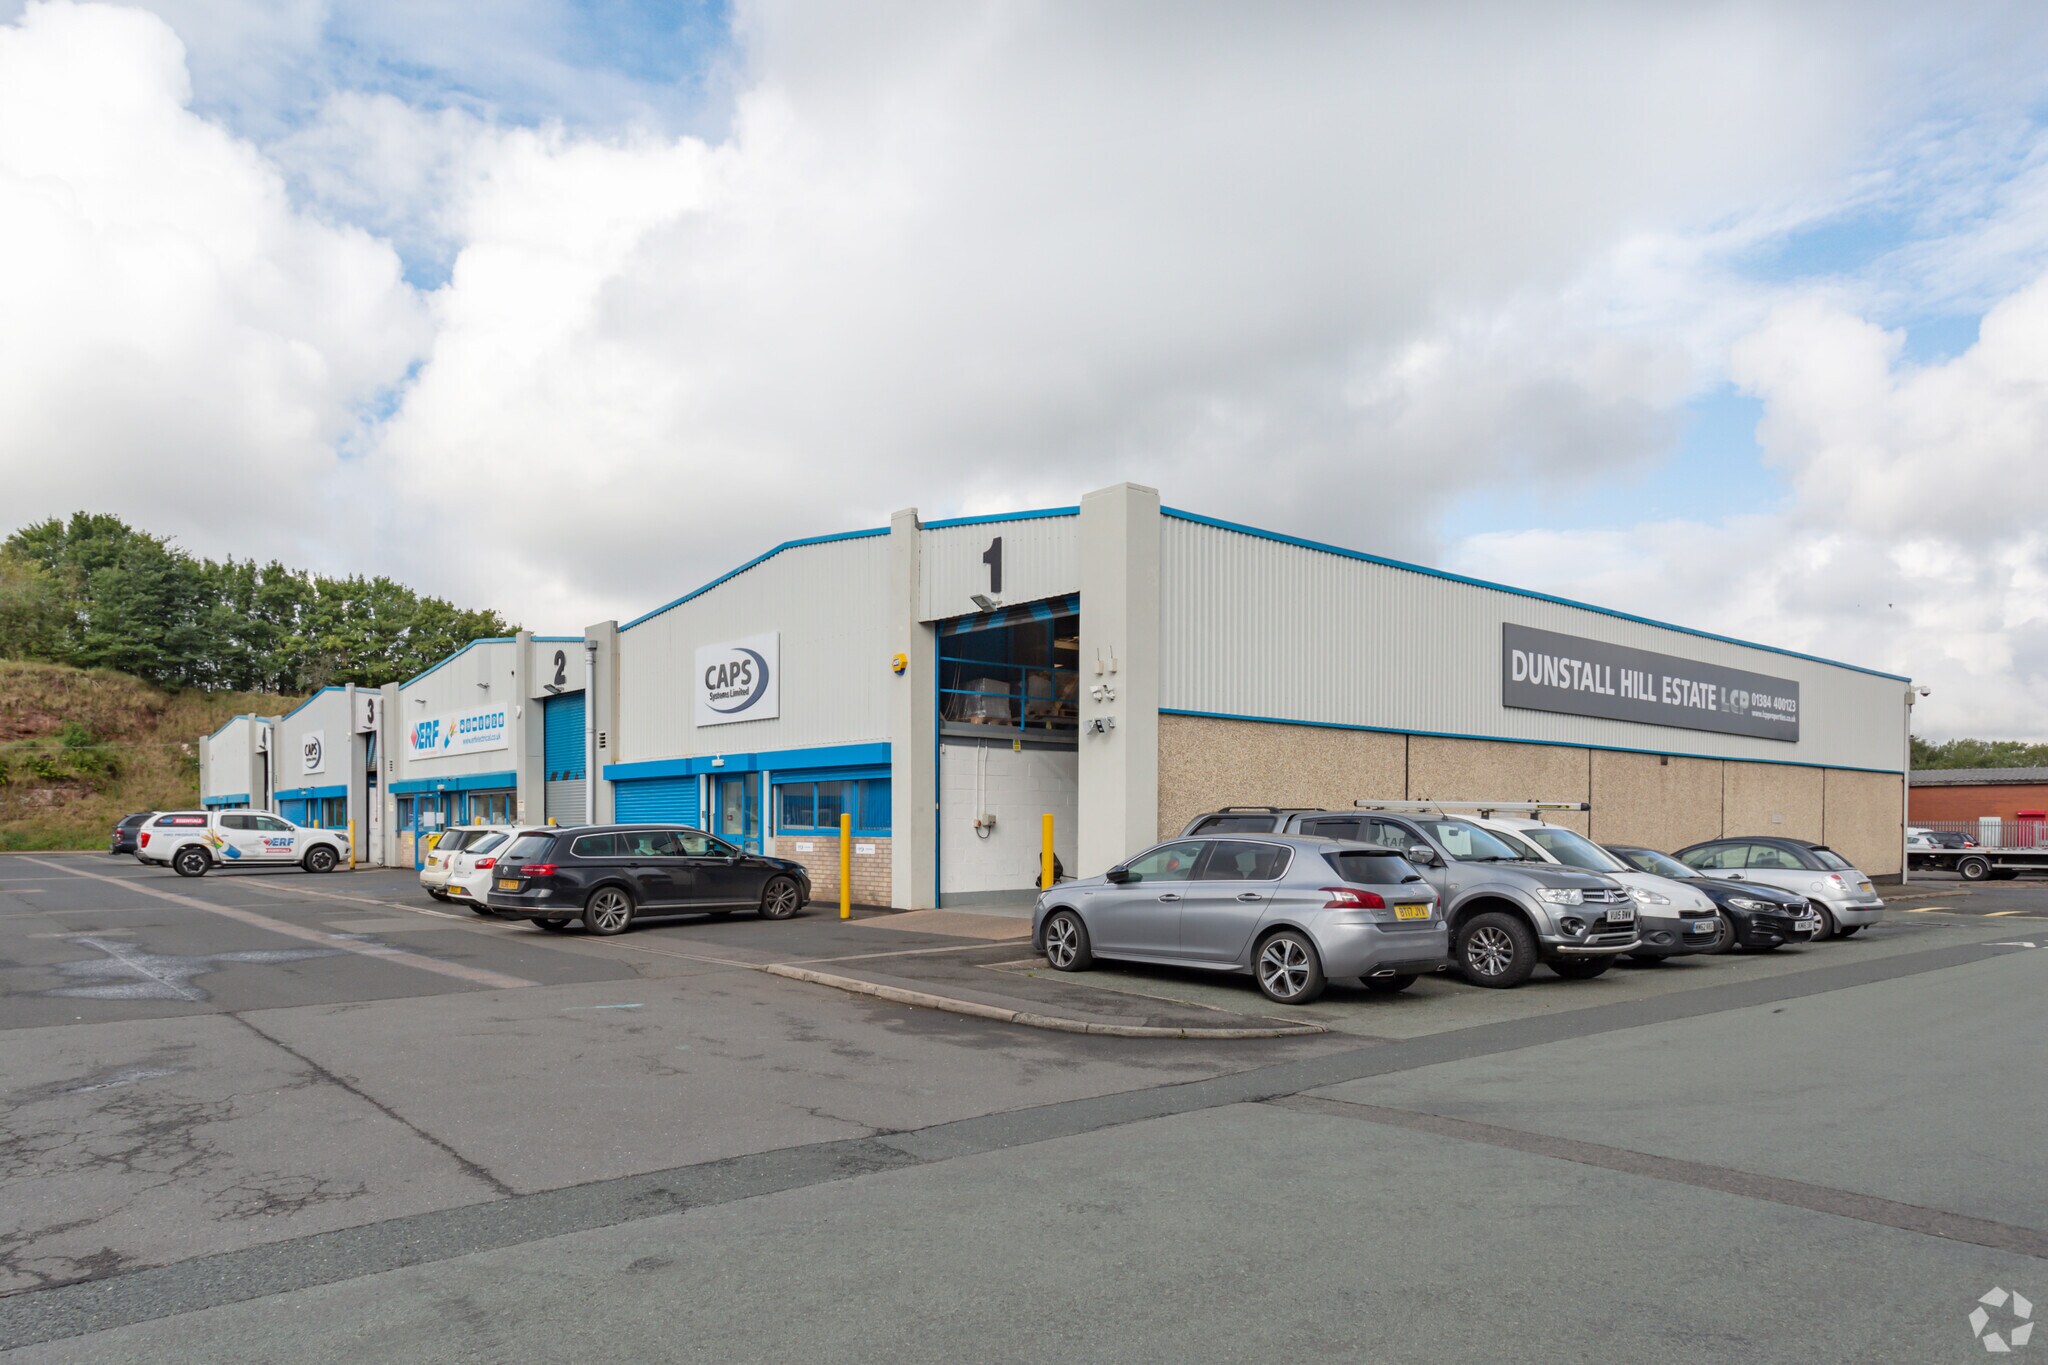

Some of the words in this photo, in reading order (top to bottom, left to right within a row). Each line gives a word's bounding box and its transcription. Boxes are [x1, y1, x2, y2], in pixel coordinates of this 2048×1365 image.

[983, 536, 1002, 594] 1
[554, 650, 566, 685] 2
[705, 659, 752, 690] CAPS
[1512, 649, 1615, 695] DUNSTALL
[1620, 668, 1657, 702] HILL
[1662, 676, 1717, 711] ESTATE
[709, 691, 729, 702] Systems
[730, 687, 749, 698] Limited
[1721, 687, 1750, 715] LCP
[1751, 692, 1772, 708] 01384
[1773, 697, 1796, 712] 400123
[367, 699, 374, 724] 3
[418, 720, 439, 749] ERF
[305, 743, 318, 757] CAPS
[272, 838, 294, 847] ERF
[1398, 906, 1413, 918] BT17
